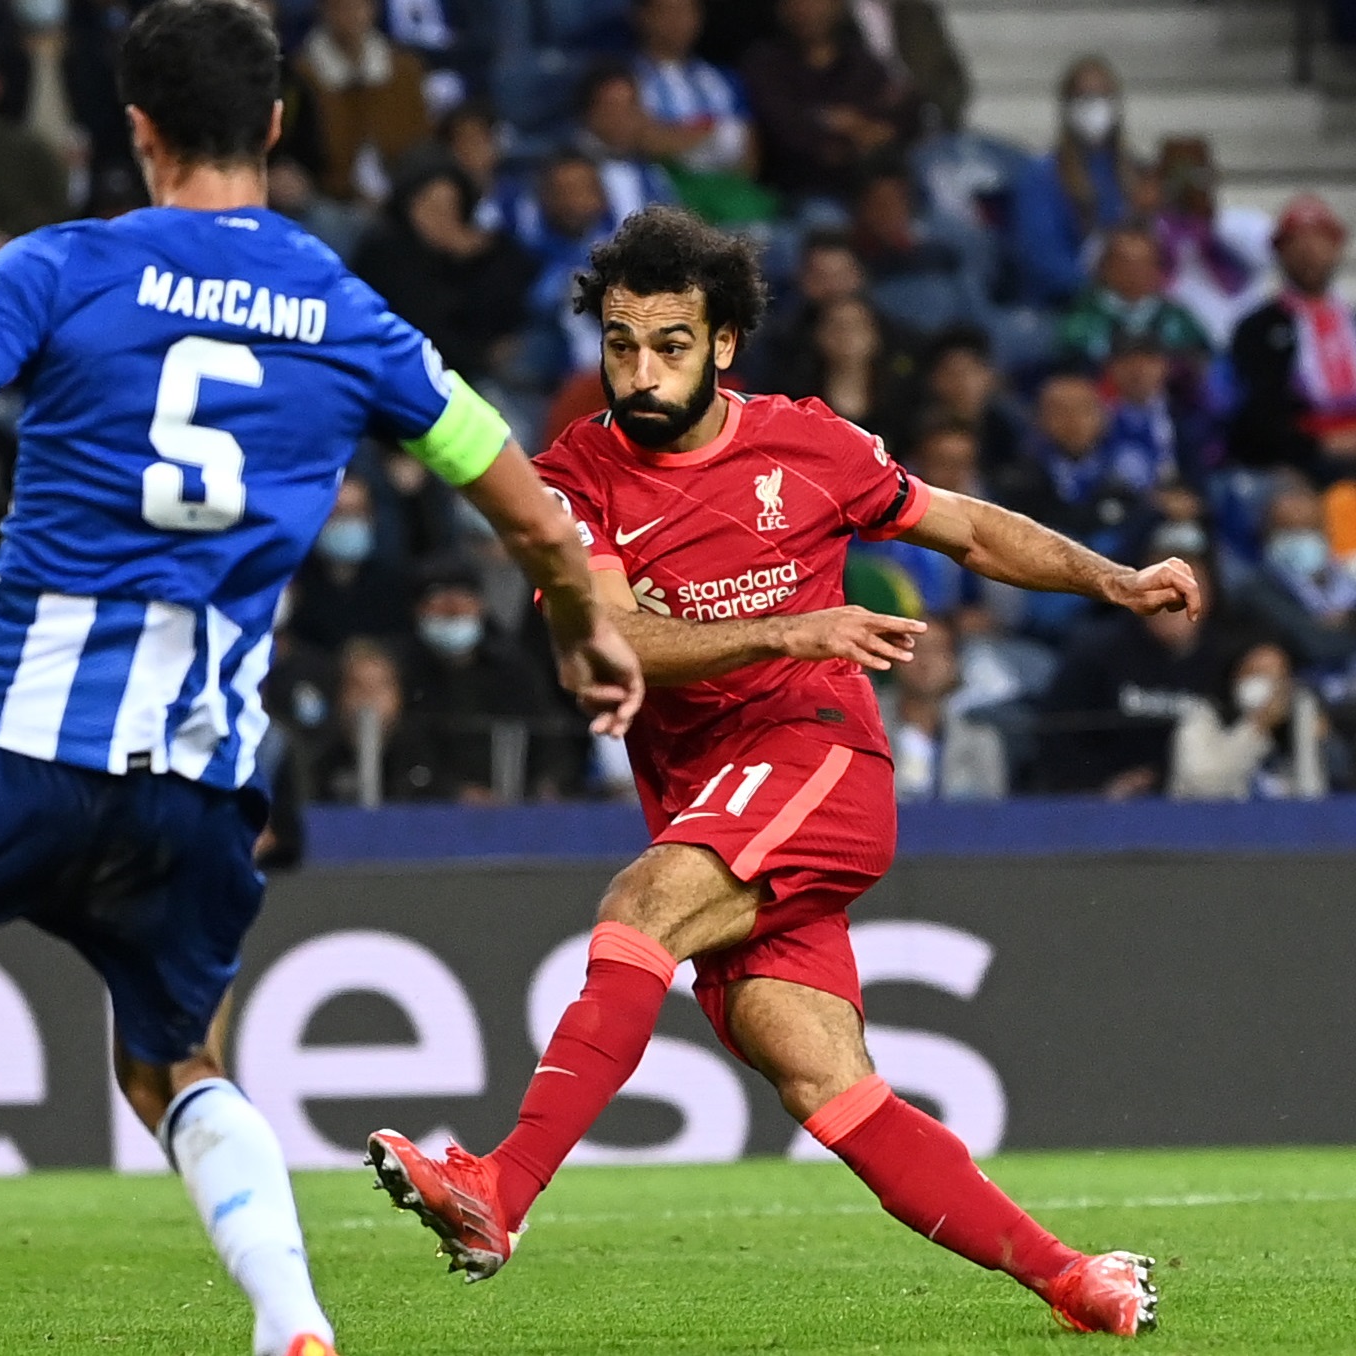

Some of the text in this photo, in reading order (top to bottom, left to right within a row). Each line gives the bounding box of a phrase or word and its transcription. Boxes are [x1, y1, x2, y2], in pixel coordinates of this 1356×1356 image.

[137, 265, 328, 344] MARCANO
[142, 334, 264, 531] 5
[678, 559, 798, 603] standard
[688, 761, 773, 817] 11
